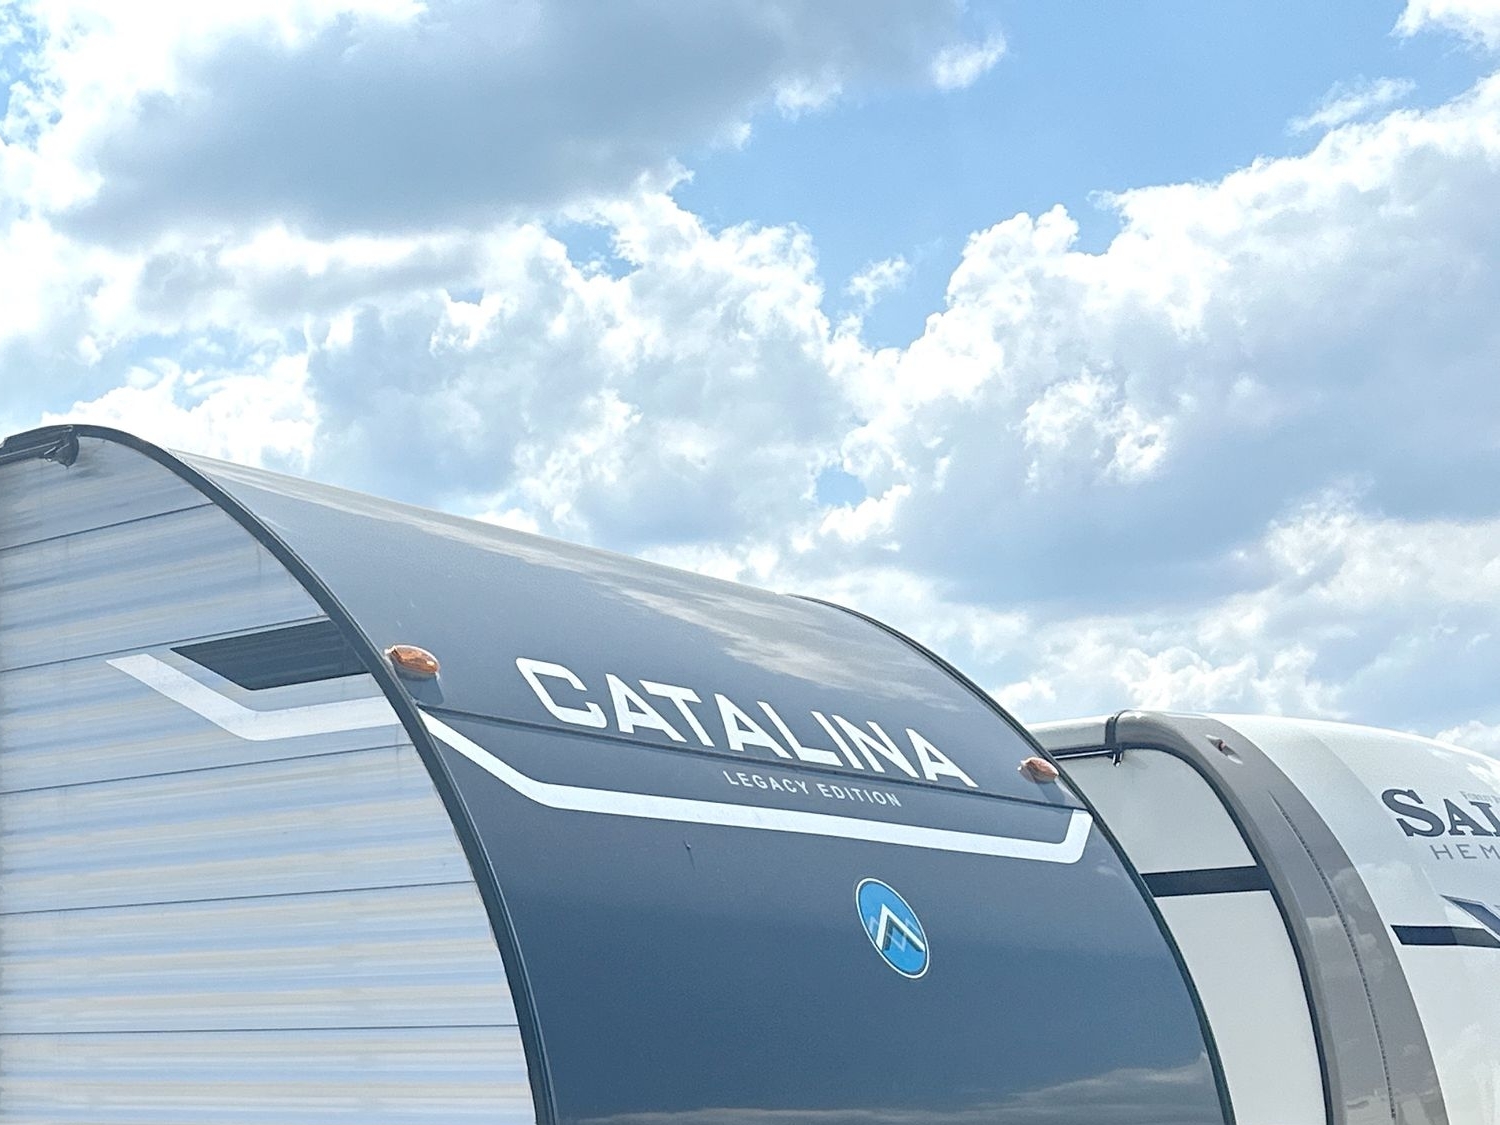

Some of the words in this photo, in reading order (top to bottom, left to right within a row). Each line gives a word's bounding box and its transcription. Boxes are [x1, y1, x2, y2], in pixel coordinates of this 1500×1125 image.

[515, 656, 978, 788] CATALINA
[722, 770, 809, 794] LEGACY
[816, 783, 902, 807] EDITION
